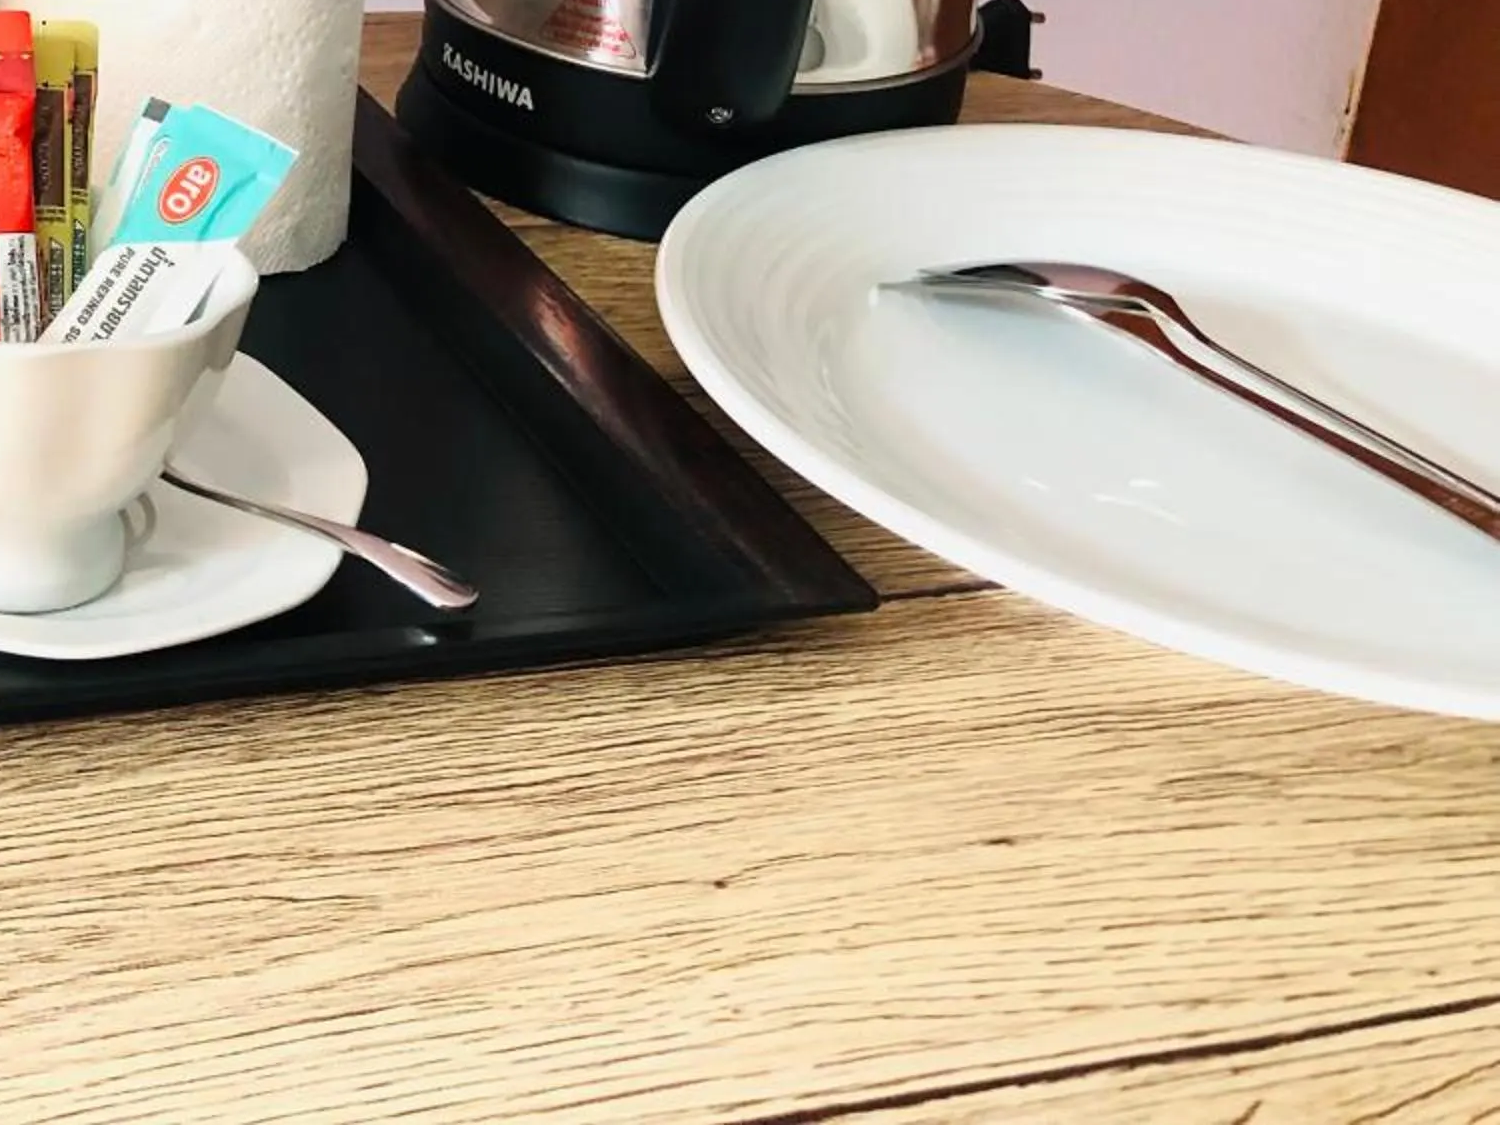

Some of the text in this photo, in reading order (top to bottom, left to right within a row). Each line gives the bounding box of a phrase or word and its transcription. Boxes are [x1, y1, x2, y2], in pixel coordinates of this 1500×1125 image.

[443, 42, 534, 111] KASHIWA
[166, 164, 212, 215] aro
[109, 246, 136, 277] PURE
[77, 276, 115, 326] REFINED
[91, 246, 176, 340] น้ำตาลทรายขา
[61, 325, 81, 344] SU
